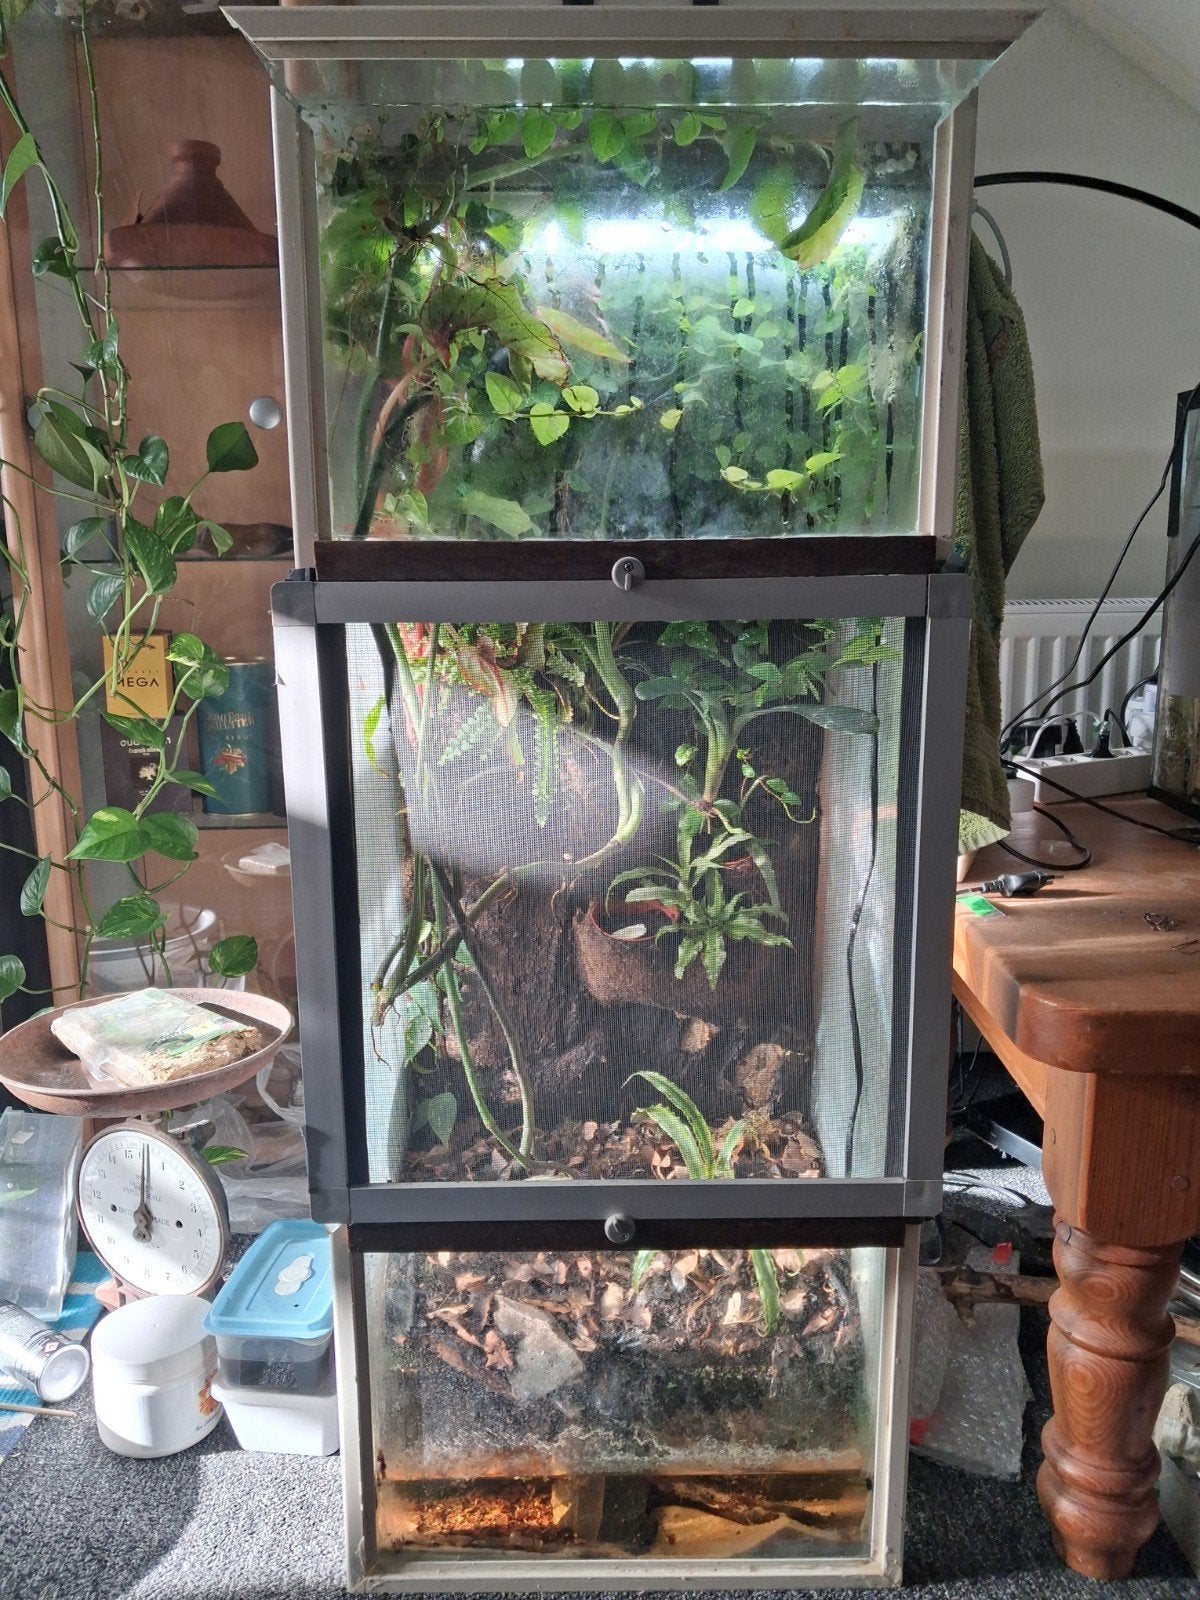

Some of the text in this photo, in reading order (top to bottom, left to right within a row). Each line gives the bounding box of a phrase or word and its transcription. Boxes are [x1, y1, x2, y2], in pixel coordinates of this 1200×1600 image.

[108, 1154, 116, 1165] 14
[124, 1149, 133, 1160] 15
[161, 1161, 165, 1171] 1
[98, 1168, 107, 1179] 13
[179, 1180, 185, 1190] 2
[93, 1189, 102, 1200] 12
[190, 1203, 197, 1213] 3
[97, 1214, 104, 1224] 11
[196, 1228, 202, 1238] 4
[193, 1249, 200, 1260] 5
[181, 1264, 188, 1275] 6
[165, 1272, 171, 1281] 7
